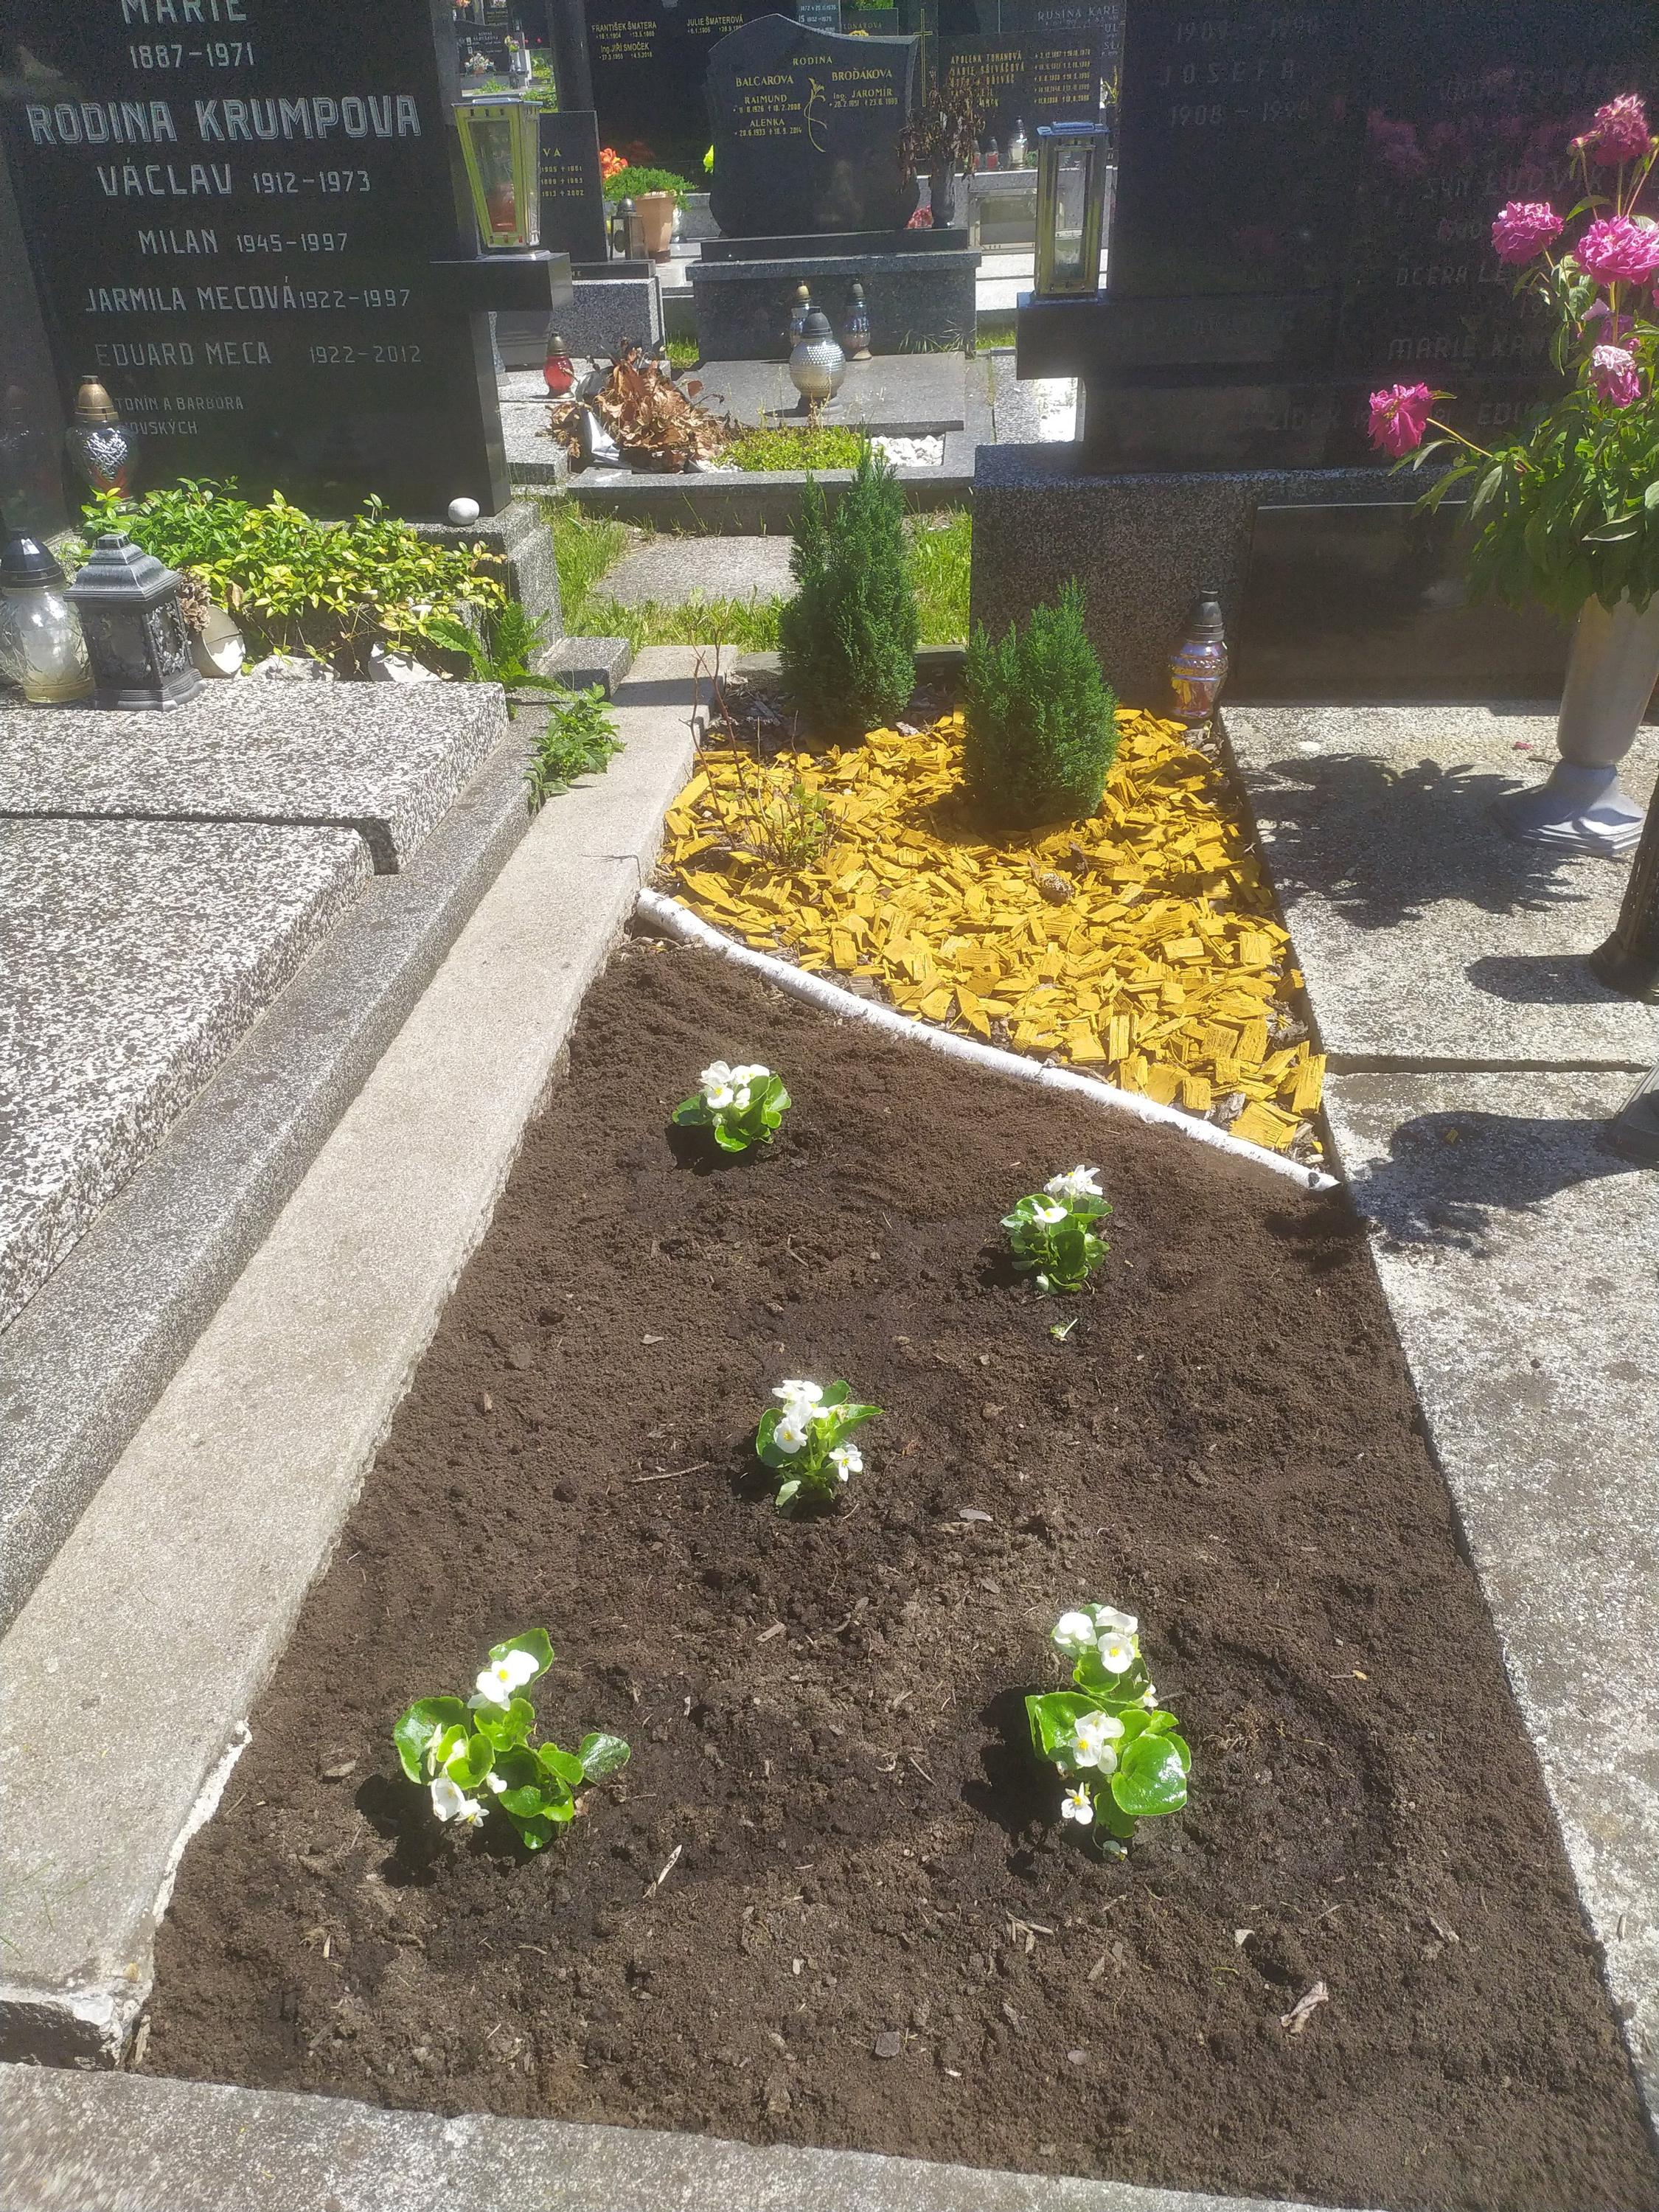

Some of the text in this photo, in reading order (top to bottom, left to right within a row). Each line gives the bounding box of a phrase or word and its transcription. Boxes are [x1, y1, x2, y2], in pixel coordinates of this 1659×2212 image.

[122, 0, 247, 24] MARIE
[686, 18, 704, 27] JULIE
[130, 42, 254, 69] 1887-1971
[793, 55, 833, 66] RODINA
[744, 94, 787, 105] RAIMUND
[25, 94, 422, 145] RODINA KRUMPOVA
[749, 118, 785, 128] ALENKA
[97, 157, 371, 196] VÁCLAV 1912-1973
[137, 229, 348, 255] MILAN 1945-1997
[85, 275, 411, 313] JARMILA MECOVÁ 1922-1997
[94, 341, 422, 367] EDUARD MECA 1922-2012
[163, 397, 173, 411] A
